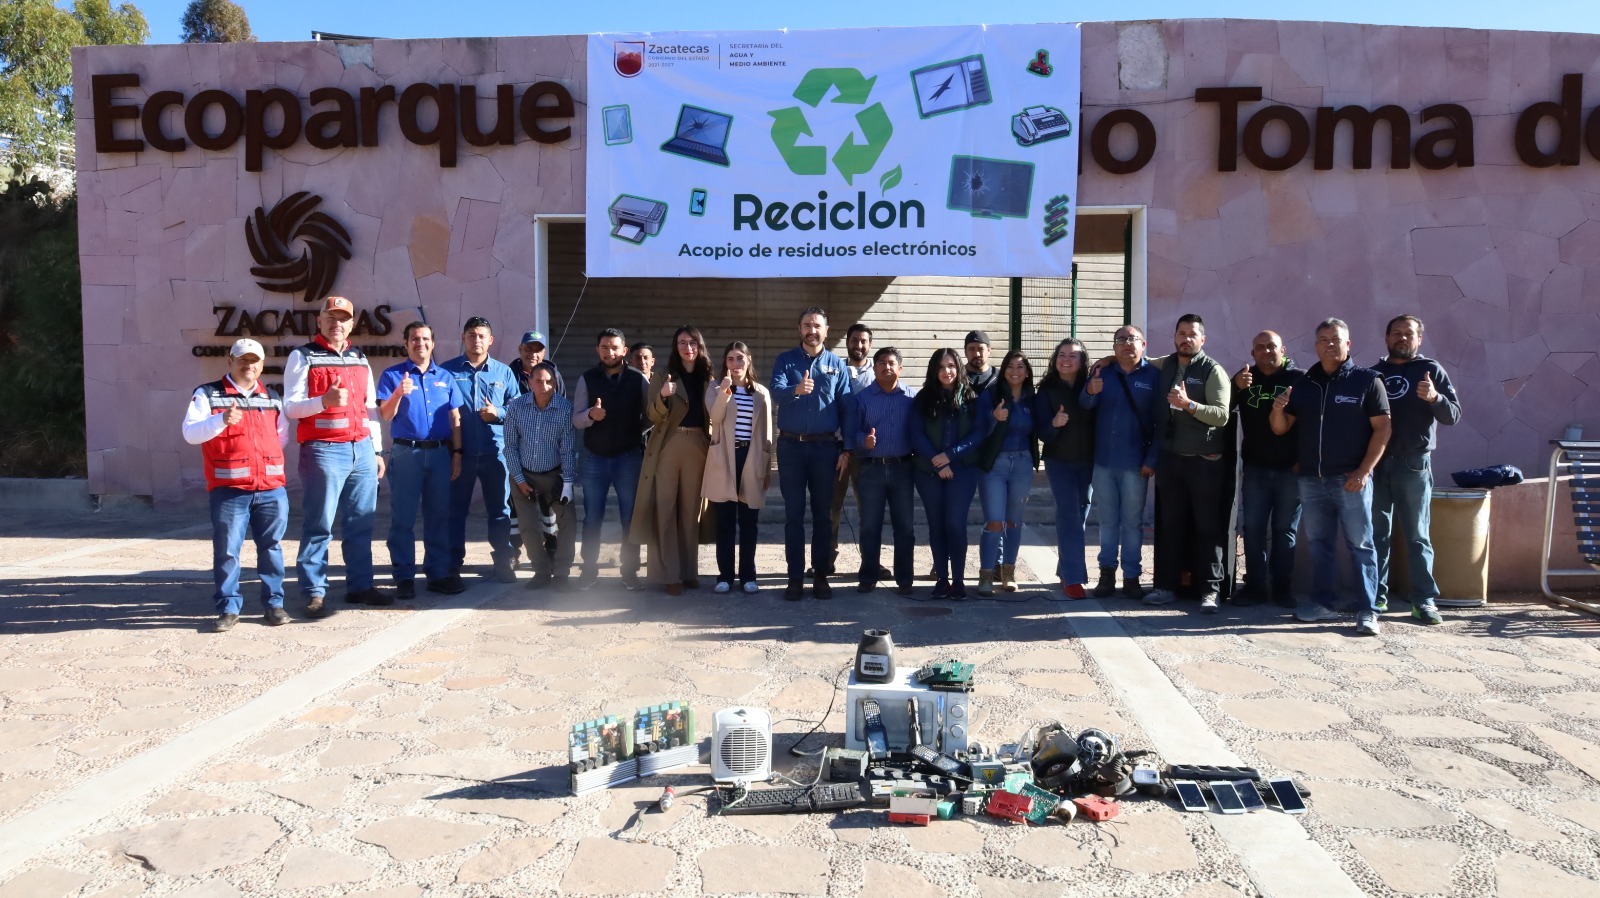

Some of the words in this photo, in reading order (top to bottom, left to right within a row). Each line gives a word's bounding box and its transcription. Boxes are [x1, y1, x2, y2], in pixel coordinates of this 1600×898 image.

[648, 44, 710, 54] Zacatecas
[92, 73, 575, 172] Ecoparque
[1195, 86, 1475, 173] Toma
[1515, 73, 1600, 169] d
[678, 242, 744, 261] Acopio
[748, 243, 773, 257] de
[777, 242, 857, 258] residuos
[862, 240, 977, 256] electrónicos
[213, 305, 392, 337] ZACATAS
